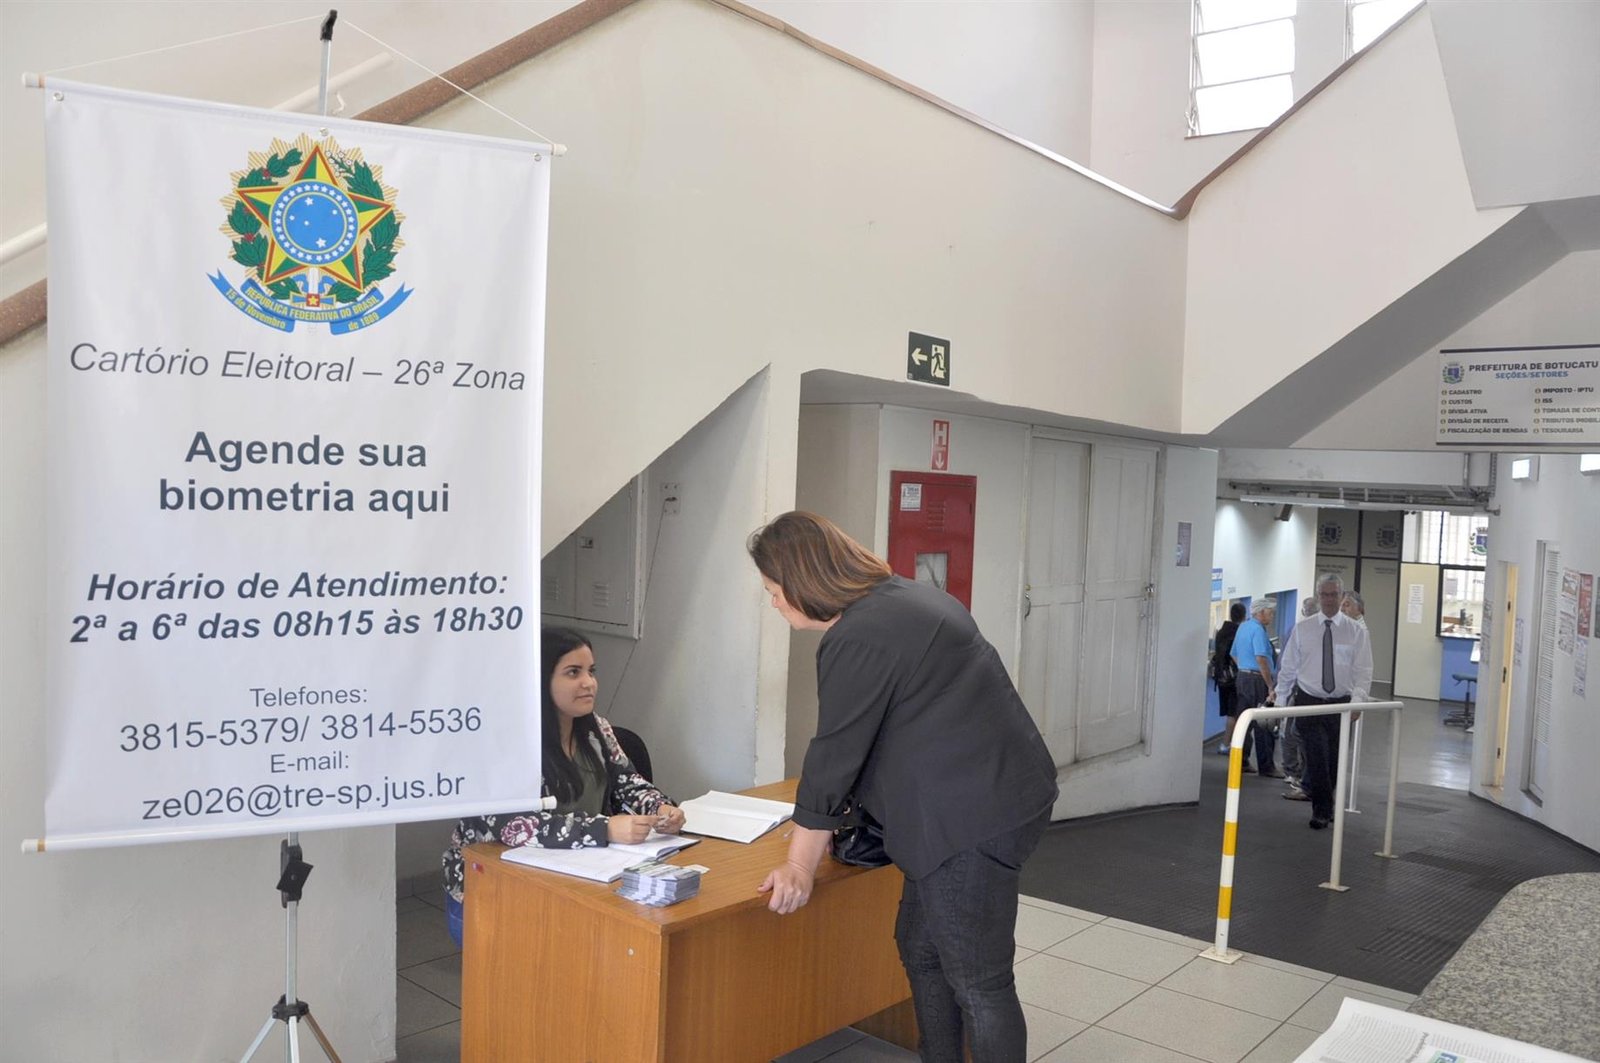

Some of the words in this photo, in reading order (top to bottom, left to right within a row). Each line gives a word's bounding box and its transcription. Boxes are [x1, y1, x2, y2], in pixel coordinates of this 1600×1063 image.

[226, 288, 235, 298] 15
[243, 304, 287, 330] Novembro
[289, 309, 339, 321] FEDERATIVA
[340, 307, 351, 319] DO
[352, 295, 379, 316] BRASIL
[348, 321, 359, 331] de
[71, 343, 209, 377] Cartório
[221, 351, 354, 383] Eleitoral
[452, 363, 525, 391] Zona
[1469, 362, 1527, 371] PREFEITURA
[1530, 362, 1542, 370] DE
[1545, 361, 1599, 369] BOTUCATU
[935, 423, 948, 446] H
[185, 431, 345, 473] Agende
[359, 444, 427, 468] sua
[160, 478, 355, 513] biometria
[369, 483, 449, 520] aqui
[87, 572, 225, 602] Horário
[237, 572, 280, 600] de
[288, 570, 508, 599] Atendimento:
[118, 620, 138, 642] a
[198, 612, 262, 641] das
[273, 609, 375, 638] 08h15
[384, 608, 421, 635] às
[434, 605, 524, 633] 18h30
[248, 686, 368, 708] Telefones:
[120, 715, 311, 753] 3815-5379/
[321, 706, 482, 741] 3814-5536
[270, 750, 349, 774] E-mail:
[142, 771, 466, 821] ze026@tre-sp.jus.br
